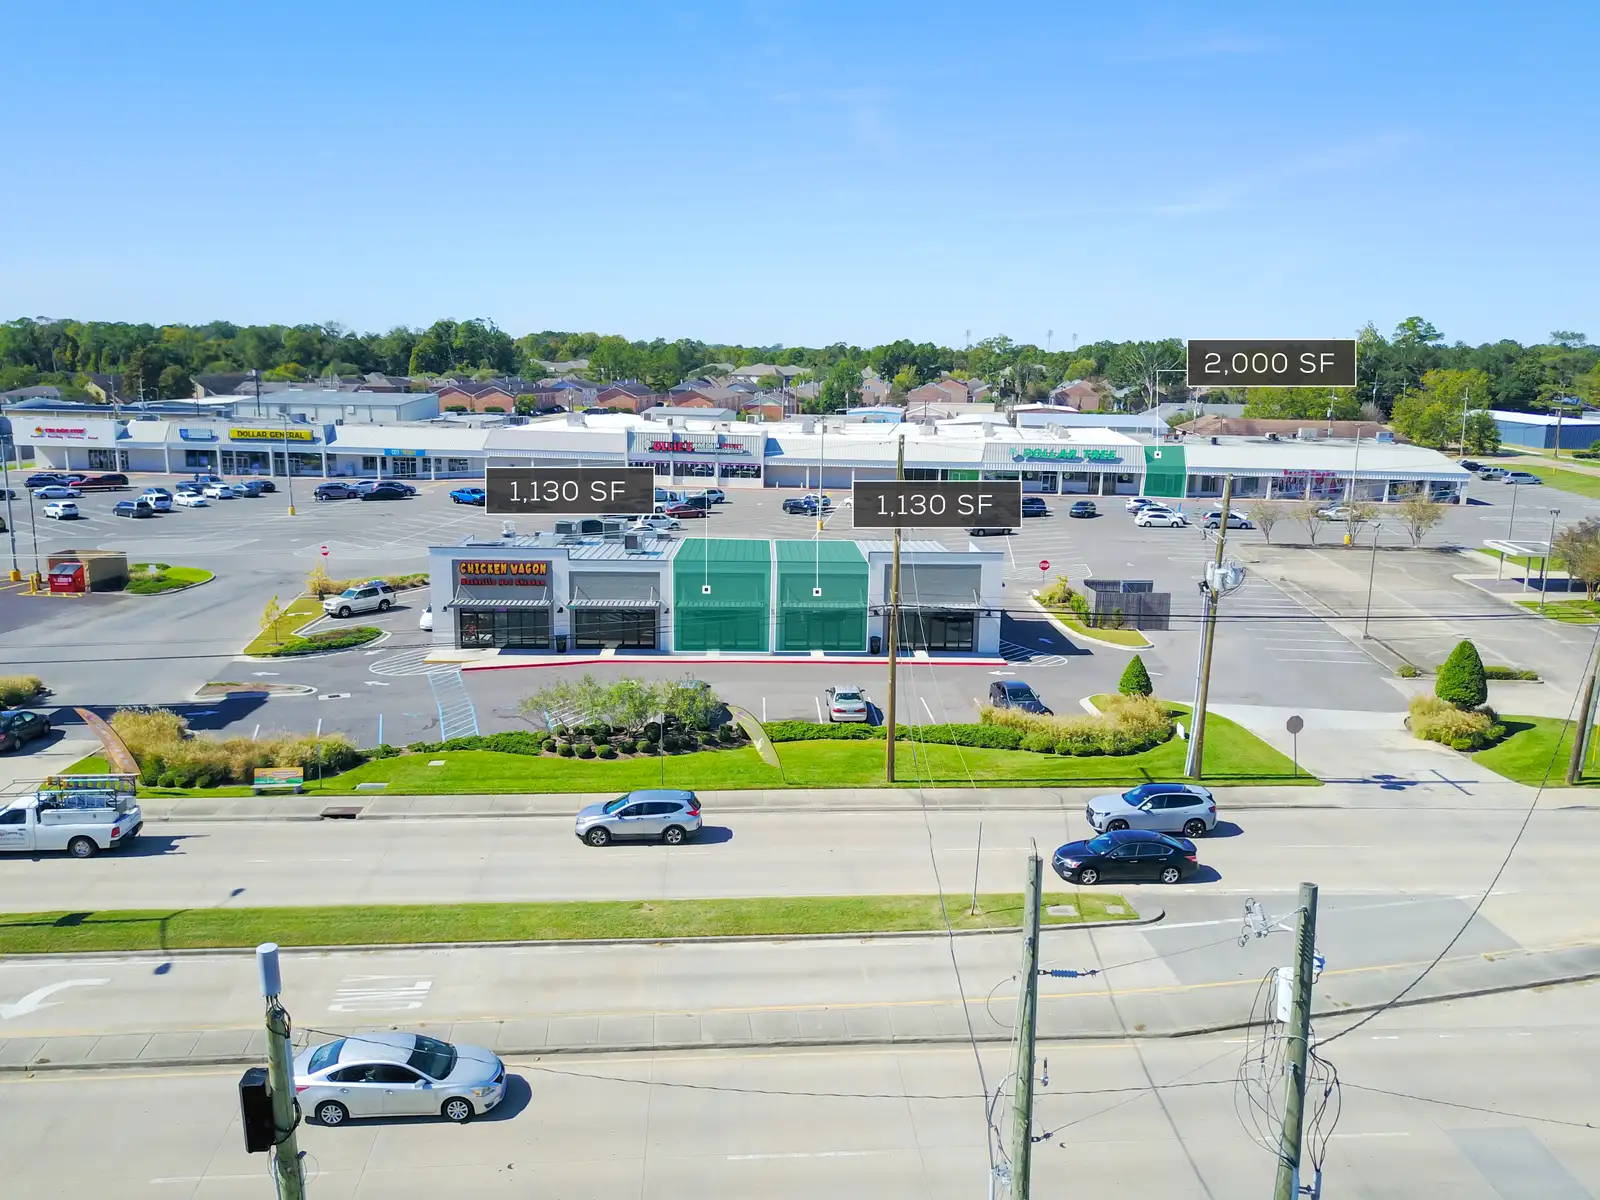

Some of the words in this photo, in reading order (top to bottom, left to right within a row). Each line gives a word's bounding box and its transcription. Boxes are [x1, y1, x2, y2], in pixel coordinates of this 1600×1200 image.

[237, 430, 269, 438] DOLLAR
[270, 431, 305, 440] GENERAL
[1023, 447, 1077, 459] DOLLAR
[1083, 449, 1117, 460] TREE
[459, 561, 507, 575] CHICKEN
[509, 562, 547, 575] WAGON
